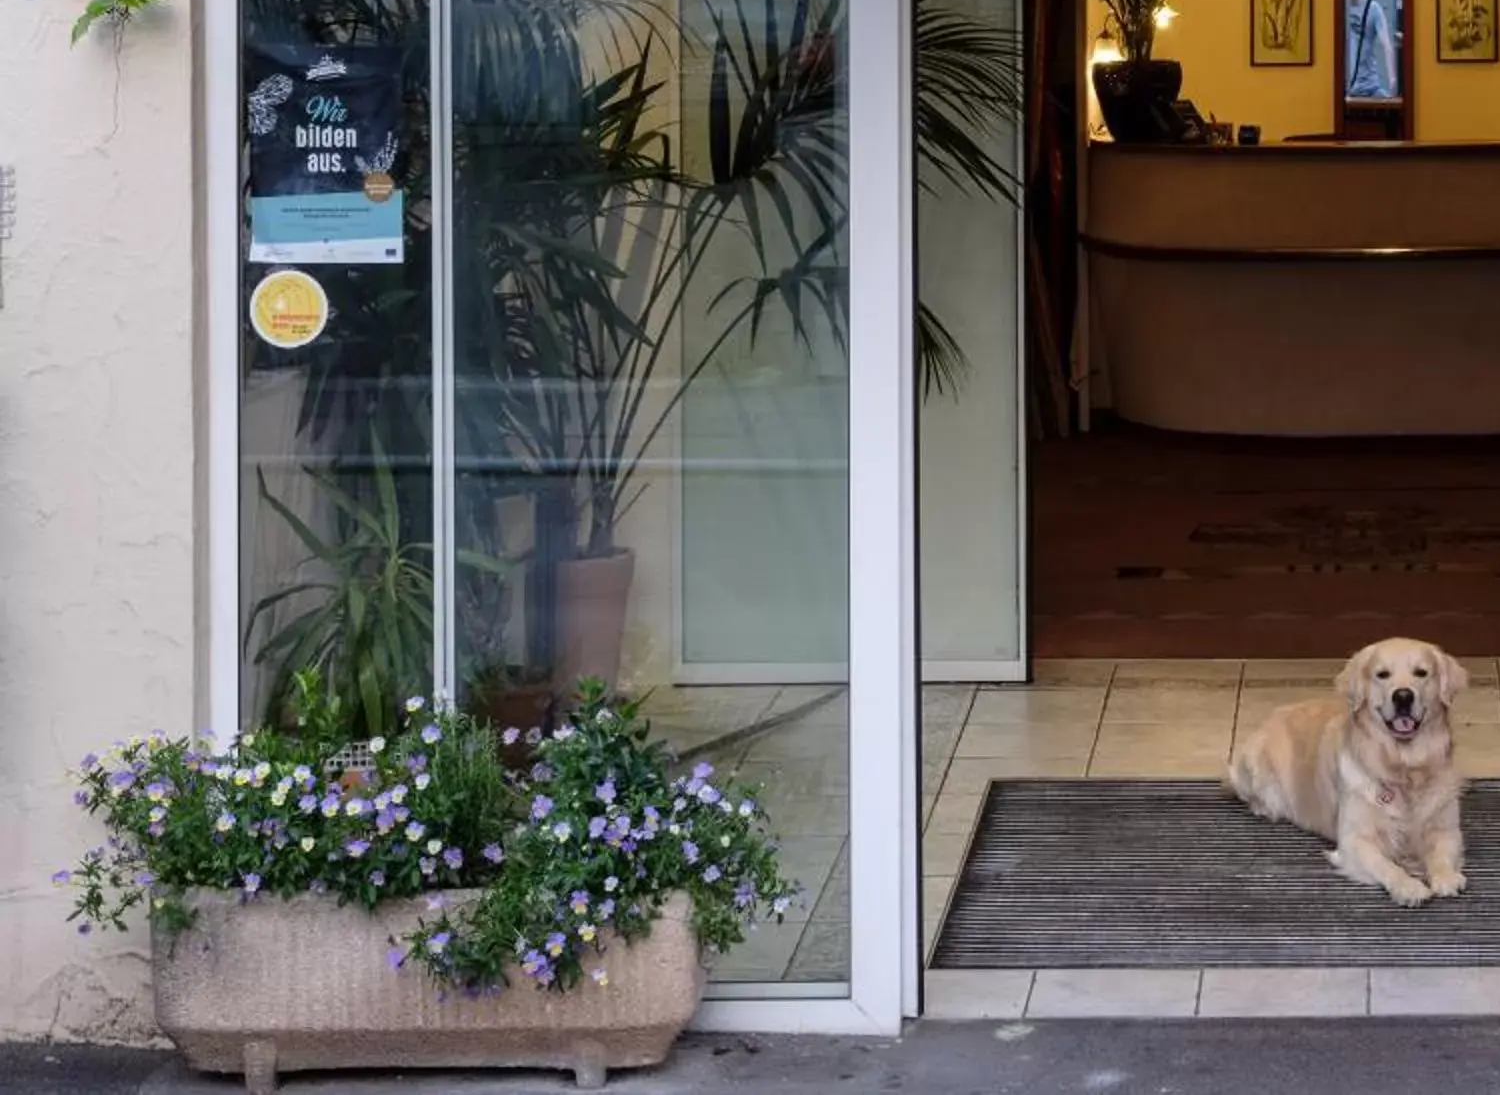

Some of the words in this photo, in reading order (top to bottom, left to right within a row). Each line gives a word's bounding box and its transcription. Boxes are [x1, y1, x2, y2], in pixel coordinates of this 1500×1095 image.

[305, 95, 348, 123] Wir
[295, 123, 358, 148] bilden
[307, 152, 347, 174] aus.
